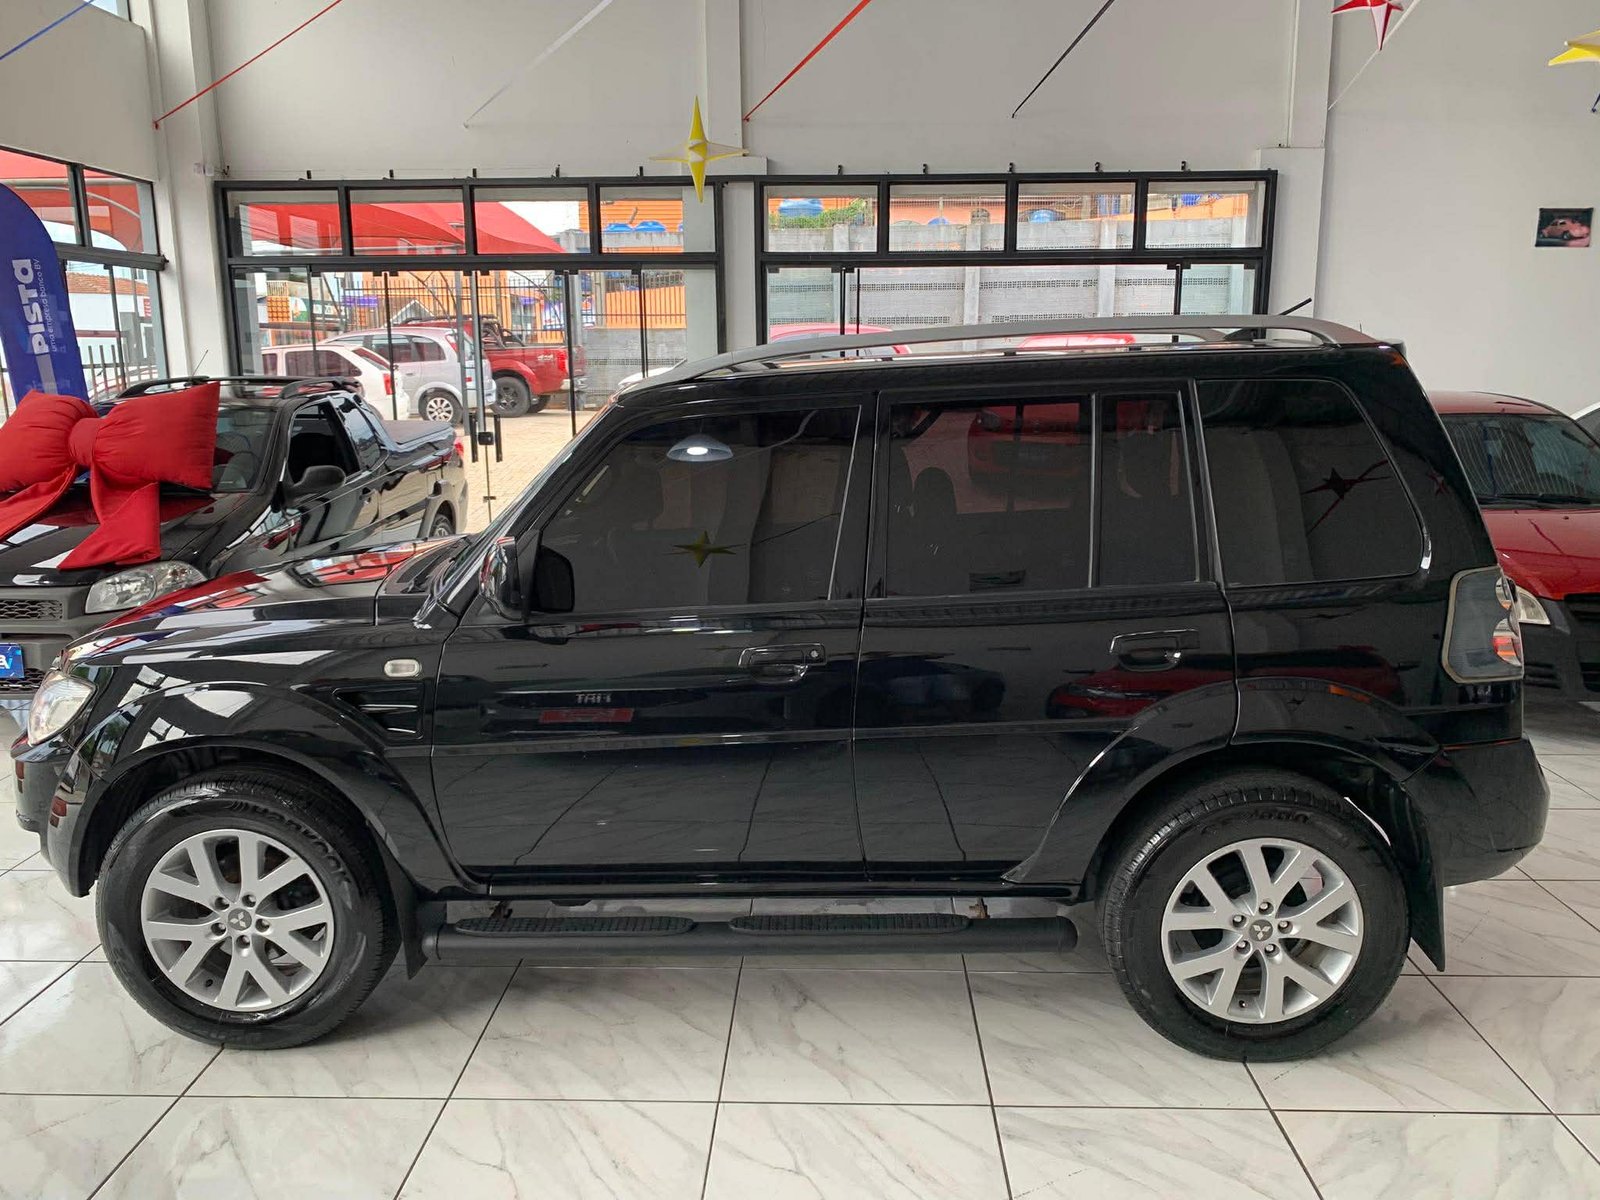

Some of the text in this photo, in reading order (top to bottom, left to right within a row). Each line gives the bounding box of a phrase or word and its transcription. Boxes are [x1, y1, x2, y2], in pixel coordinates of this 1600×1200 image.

[32, 257, 58, 352] uma empresa banco BV
